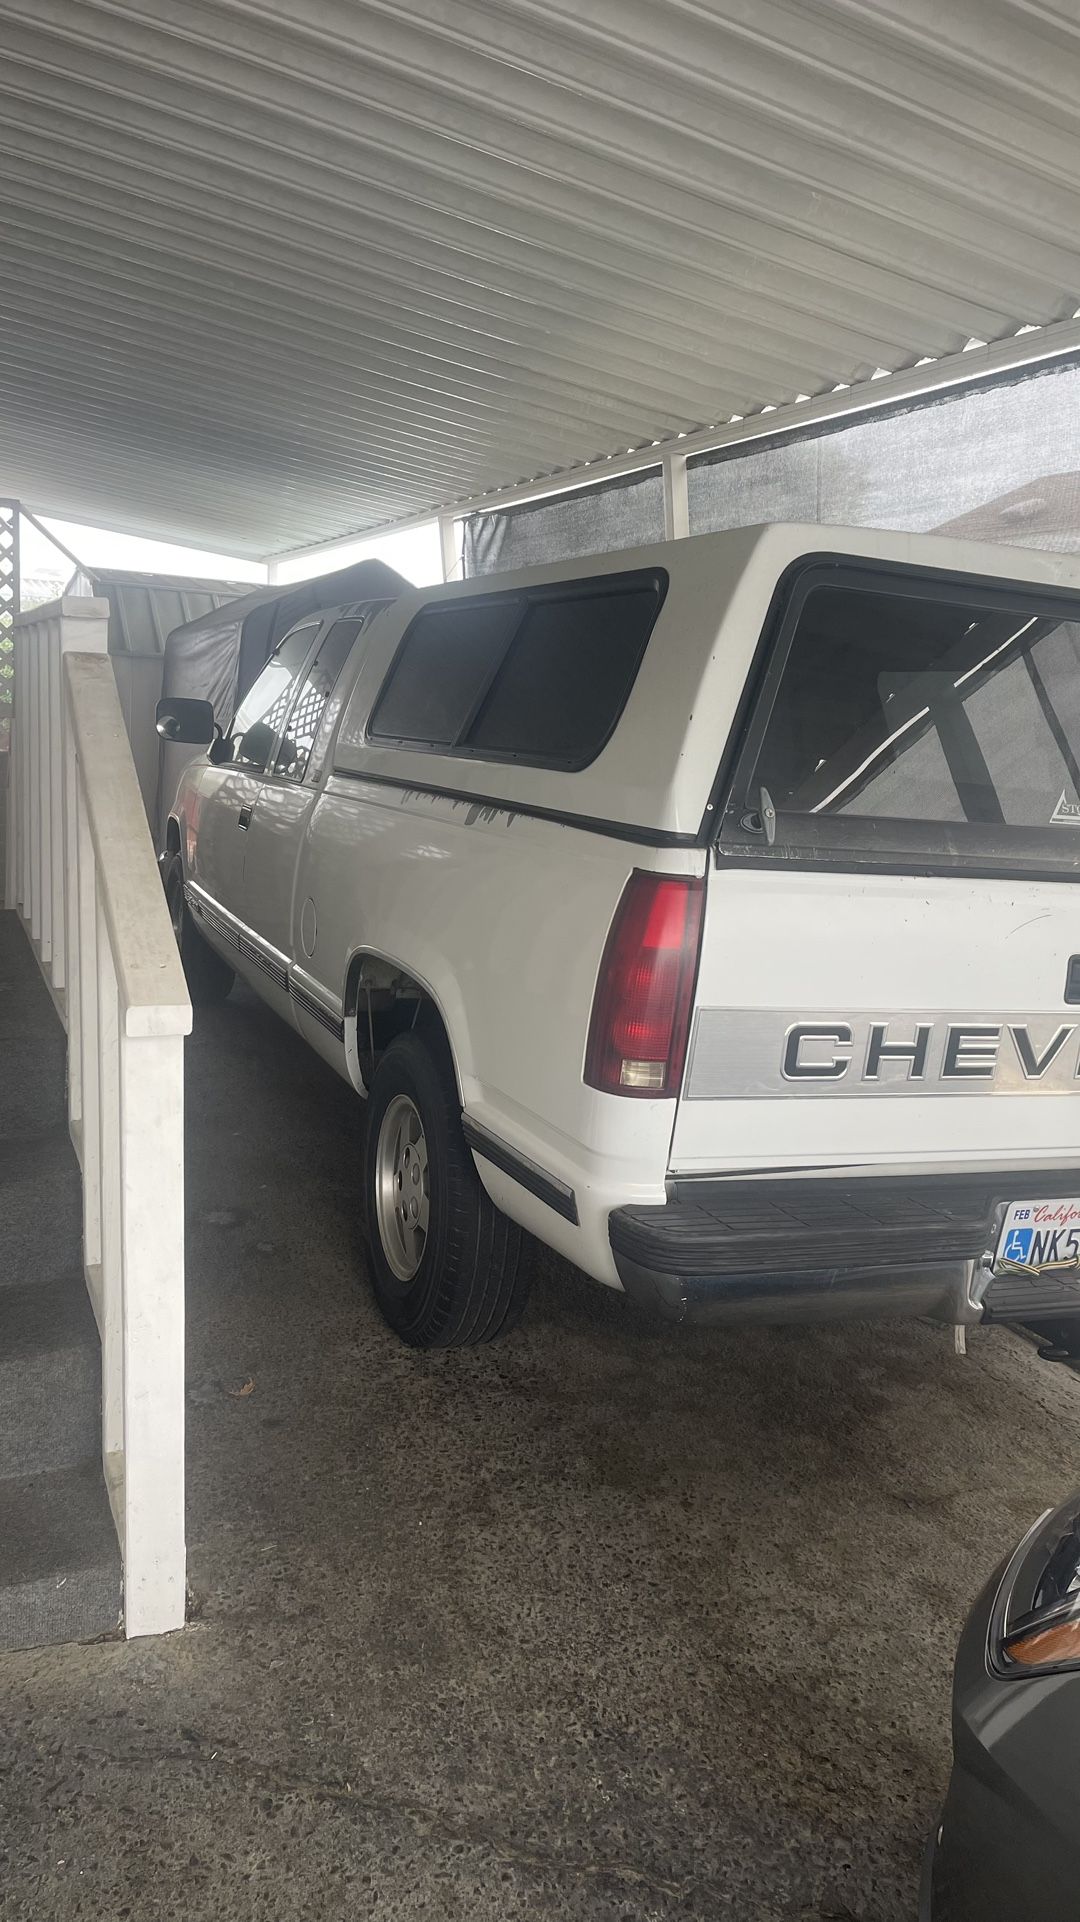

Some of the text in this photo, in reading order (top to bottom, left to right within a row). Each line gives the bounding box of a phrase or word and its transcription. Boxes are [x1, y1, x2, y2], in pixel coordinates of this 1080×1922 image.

[779, 1021, 1080, 1082] CHEV
[1013, 1209, 1031, 1220] FEB
[1029, 1228, 1080, 1266] NK5
